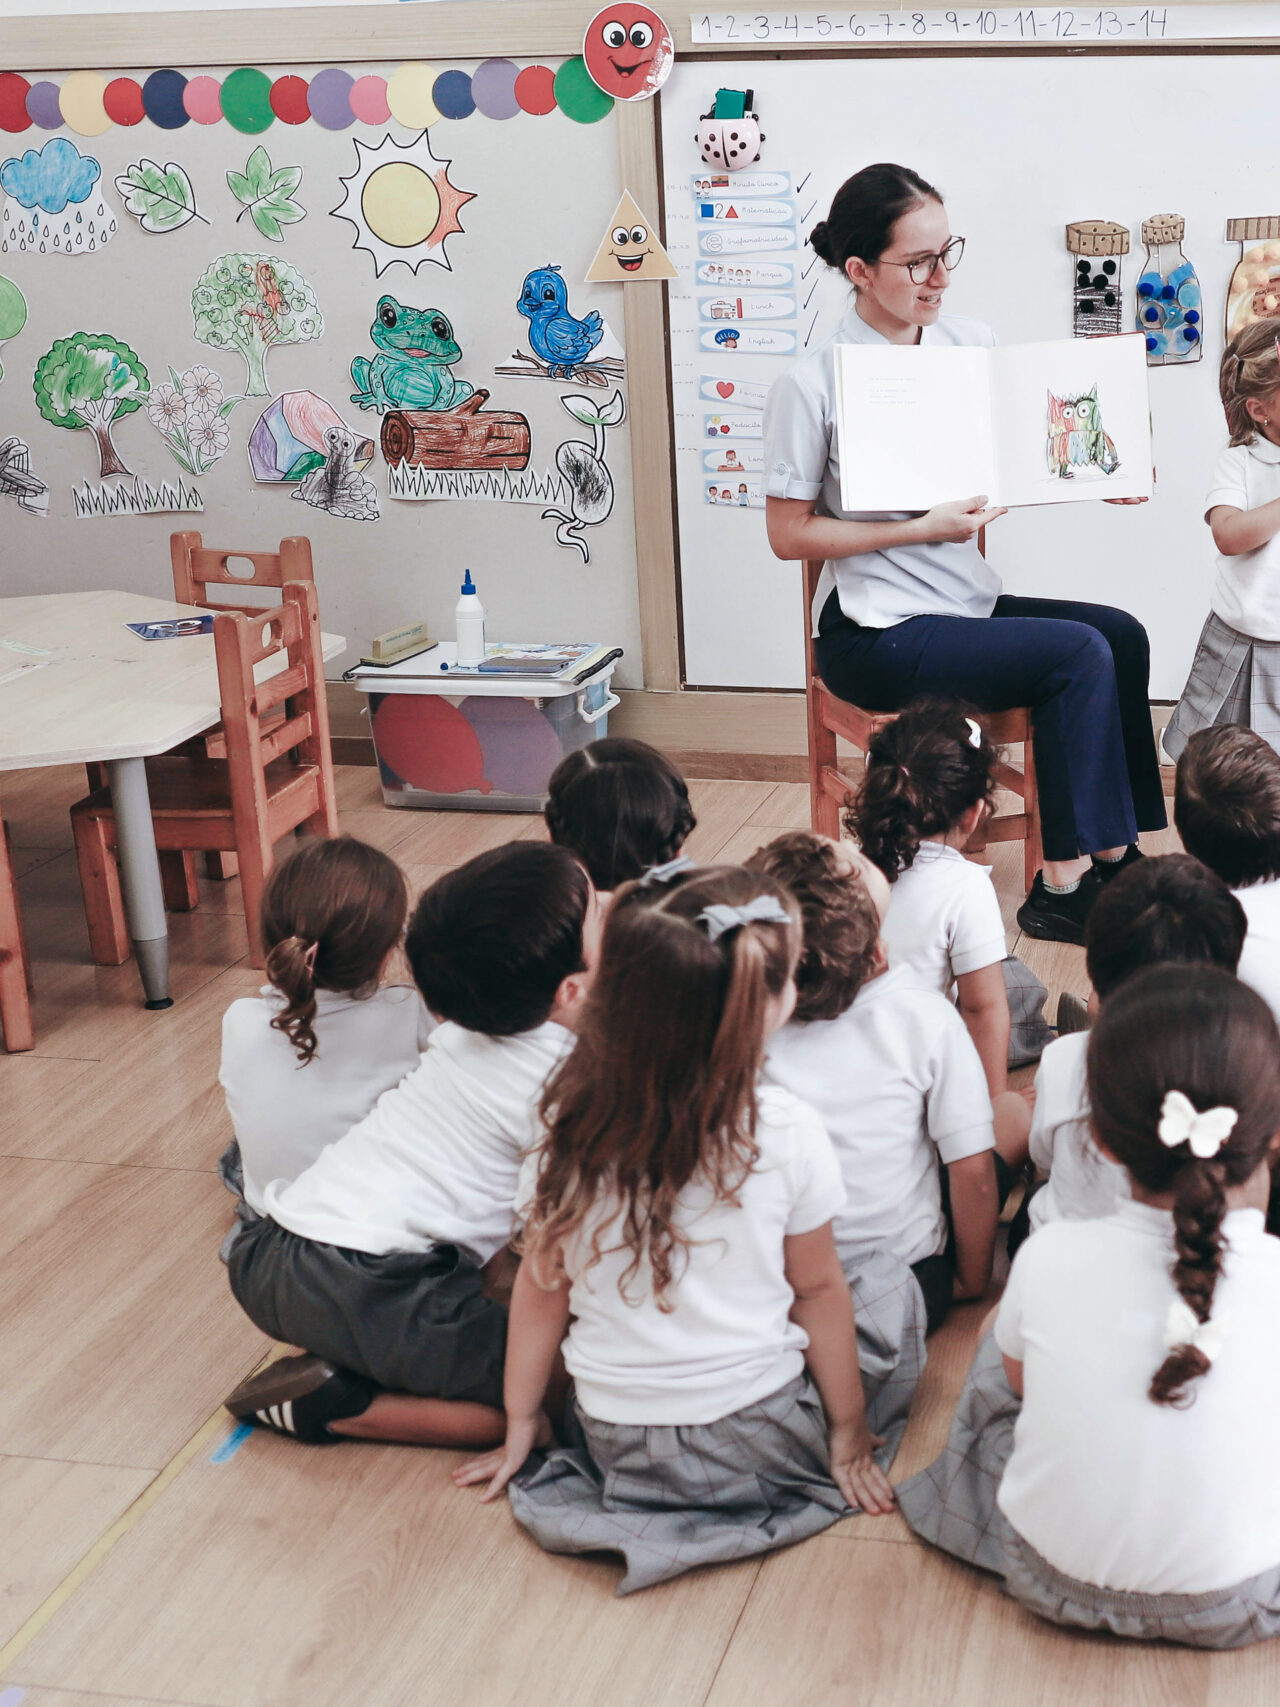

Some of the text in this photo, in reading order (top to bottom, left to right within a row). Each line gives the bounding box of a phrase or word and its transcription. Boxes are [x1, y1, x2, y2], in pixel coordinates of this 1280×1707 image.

[714, 202, 724, 220] 2
[751, 301, 775, 311] Lunch
[715, 329, 739, 344] HELLO!
